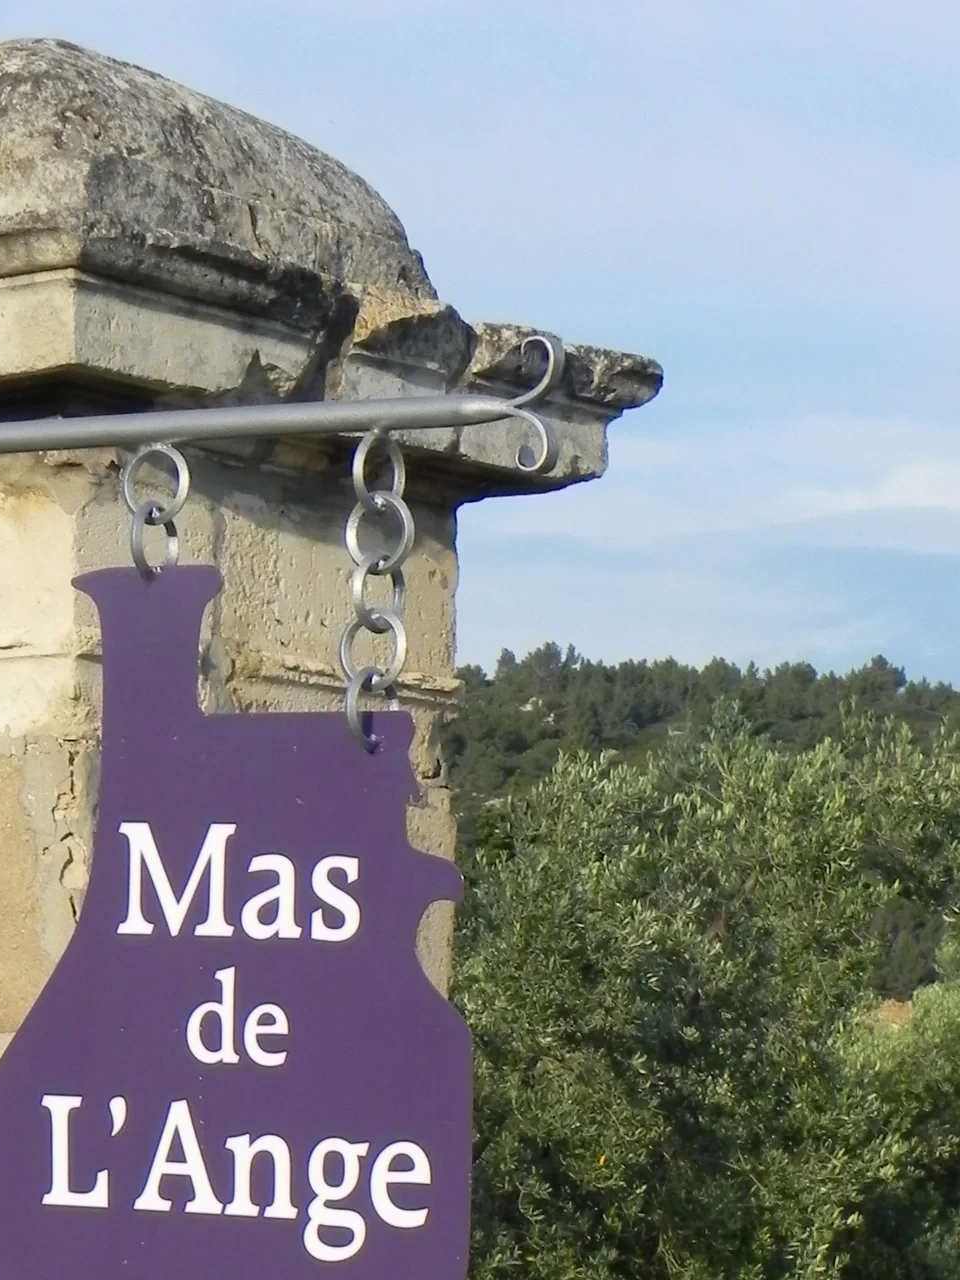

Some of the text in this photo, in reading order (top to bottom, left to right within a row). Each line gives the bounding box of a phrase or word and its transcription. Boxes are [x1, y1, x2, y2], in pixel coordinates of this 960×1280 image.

[116, 821, 361, 942] Mas
[186, 966, 290, 1067] de
[41, 1094, 432, 1262] L'Ange
